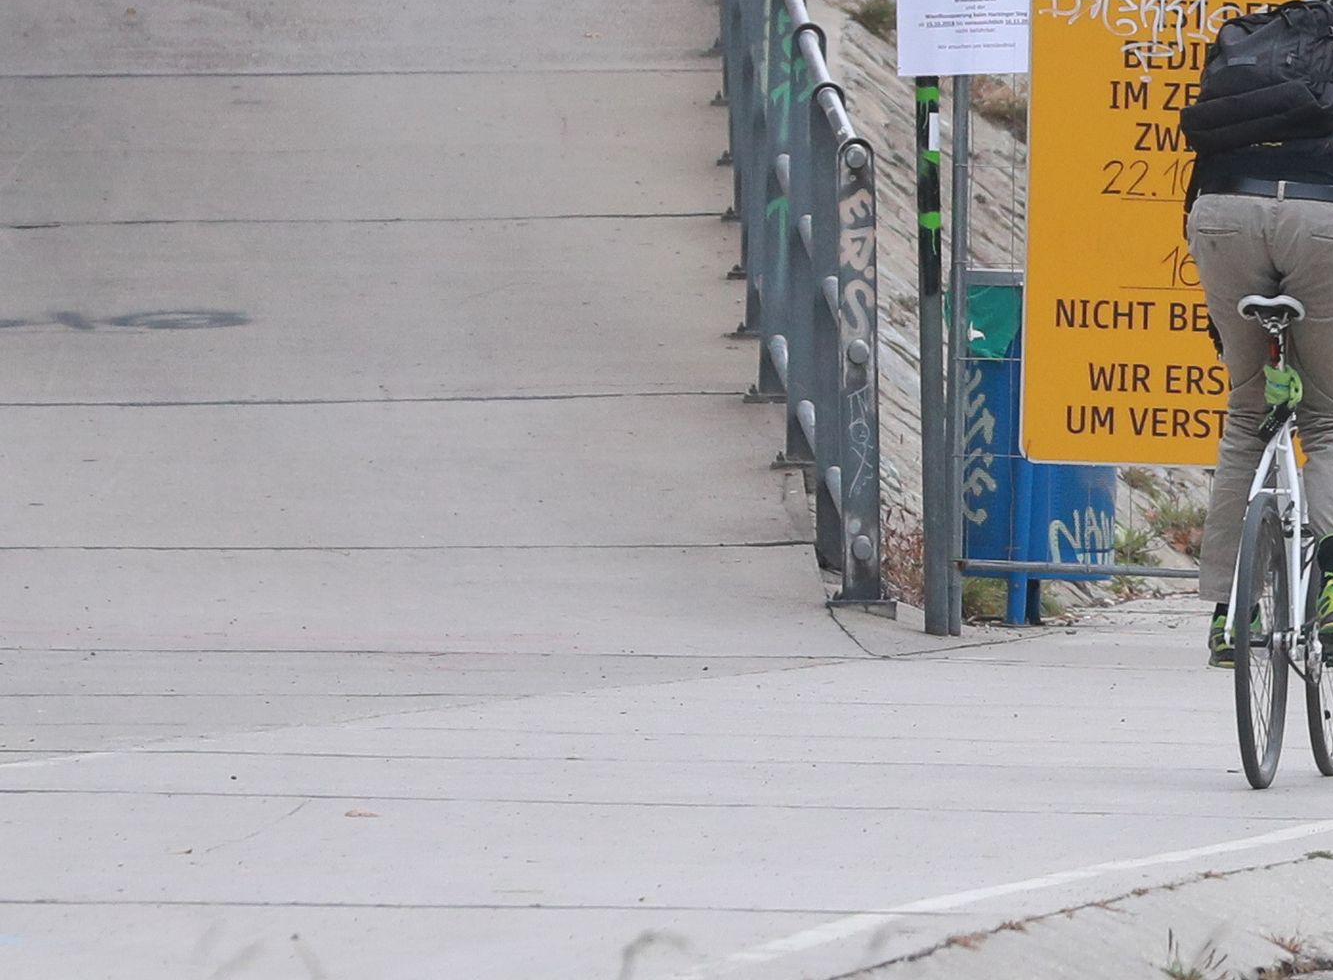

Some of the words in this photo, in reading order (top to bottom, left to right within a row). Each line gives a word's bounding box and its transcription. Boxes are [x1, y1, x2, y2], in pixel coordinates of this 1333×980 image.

[1124, 39, 1215, 71] BEDI
[1109, 80, 1149, 111] IM
[1162, 82, 1201, 112] ZE
[1101, 158, 1197, 197] 22.10
[1161, 245, 1201, 287] 16
[1055, 298, 1156, 330] NICHT
[1169, 302, 1209, 332] BE
[1088, 362, 1151, 393] WIR
[1165, 364, 1232, 396] ERS
[1066, 405, 1114, 435] UM
[1128, 406, 1229, 439] VERST
